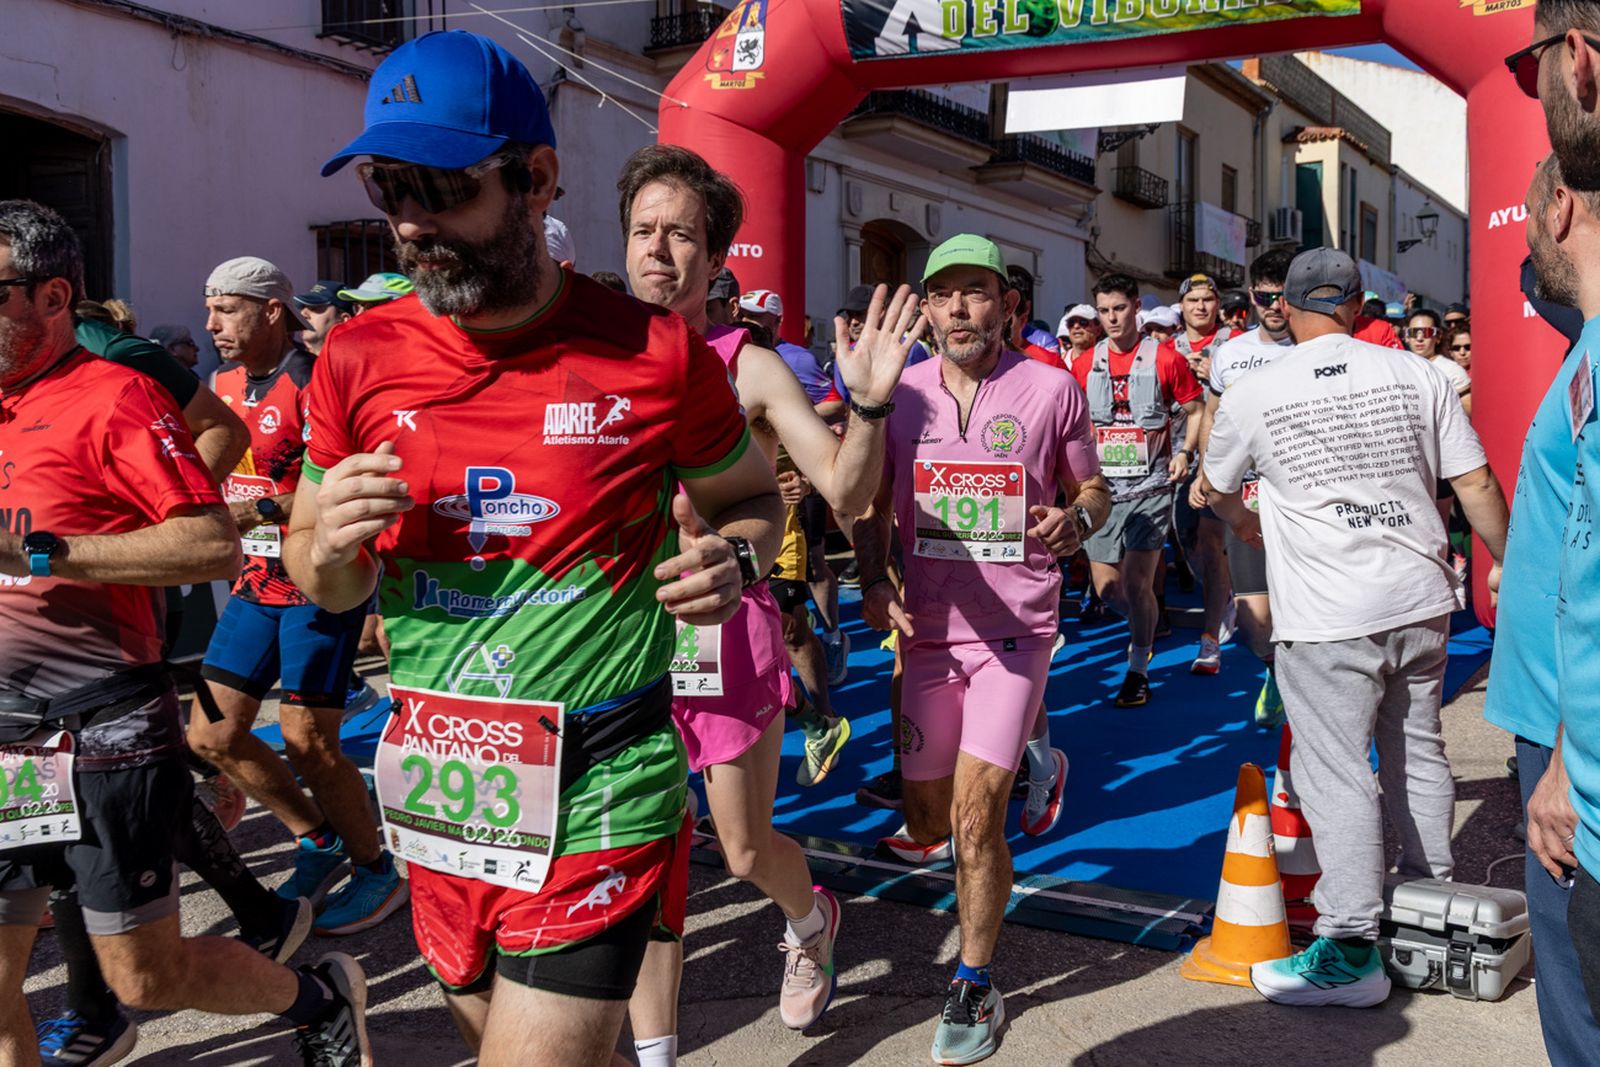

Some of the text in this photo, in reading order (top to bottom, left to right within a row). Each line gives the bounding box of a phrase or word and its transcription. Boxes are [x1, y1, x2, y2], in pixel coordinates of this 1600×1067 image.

[941, 0, 1029, 39] DEL
[1485, 0, 1521, 12] MARTOS
[1488, 203, 1530, 229] AYU
[1314, 363, 1348, 379] PONY
[1265, 414, 1292, 428] BROKEN
[1293, 410, 1311, 419] NEW
[1312, 406, 1334, 415] YORK
[1336, 403, 1354, 411] WAS
[1354, 401, 1367, 409] TO
[1367, 395, 1388, 406] STAY
[1389, 393, 1401, 401] ON
[1270, 405, 1285, 415] THE
[1285, 401, 1309, 411] EARLY
[1332, 394, 1348, 402] THE
[1349, 390, 1370, 400] ONLY
[1371, 384, 1392, 394] RULE
[543, 402, 596, 436] ATARFE
[1273, 435, 1292, 447] WITH
[1371, 414, 1408, 426] DESIGNED
[1288, 420, 1311, 431] WHEN
[1311, 416, 1334, 425] PONY
[1359, 404, 1401, 419] APPEARED
[543, 435, 630, 446] Atletismo Atarfe
[1103, 430, 1137, 440] X CROSS
[1272, 449, 1287, 458] REAL
[1319, 436, 1335, 444] NEW
[1337, 431, 1373, 441] YORKERS
[1279, 454, 1302, 466] BRAND
[1302, 448, 1322, 458] THEY
[1324, 442, 1362, 453] IDENTIFIED
[1298, 457, 1332, 471] SURVIVE
[1370, 450, 1389, 459] CITY
[930, 467, 1006, 488] X CROSS
[1288, 474, 1306, 485] PONY
[1324, 465, 1347, 475] SINCE
[1391, 457, 1407, 466] THE
[1303, 482, 1313, 491] OF
[1320, 477, 1336, 486] CITY
[1338, 473, 1358, 482] THAT
[1377, 470, 1394, 479] LIES
[465, 466, 543, 518] Poncho
[929, 485, 993, 499] PANTANO
[933, 496, 999, 531] 191
[1347, 513, 1413, 528] NEW YORK
[404, 698, 425, 735] X
[427, 714, 523, 747] CROSS
[401, 733, 523, 767] PANTANO DEL
[401, 754, 521, 828] 293
[383, 808, 413, 825] PEDRO
[414, 817, 446, 832] JAVIER
